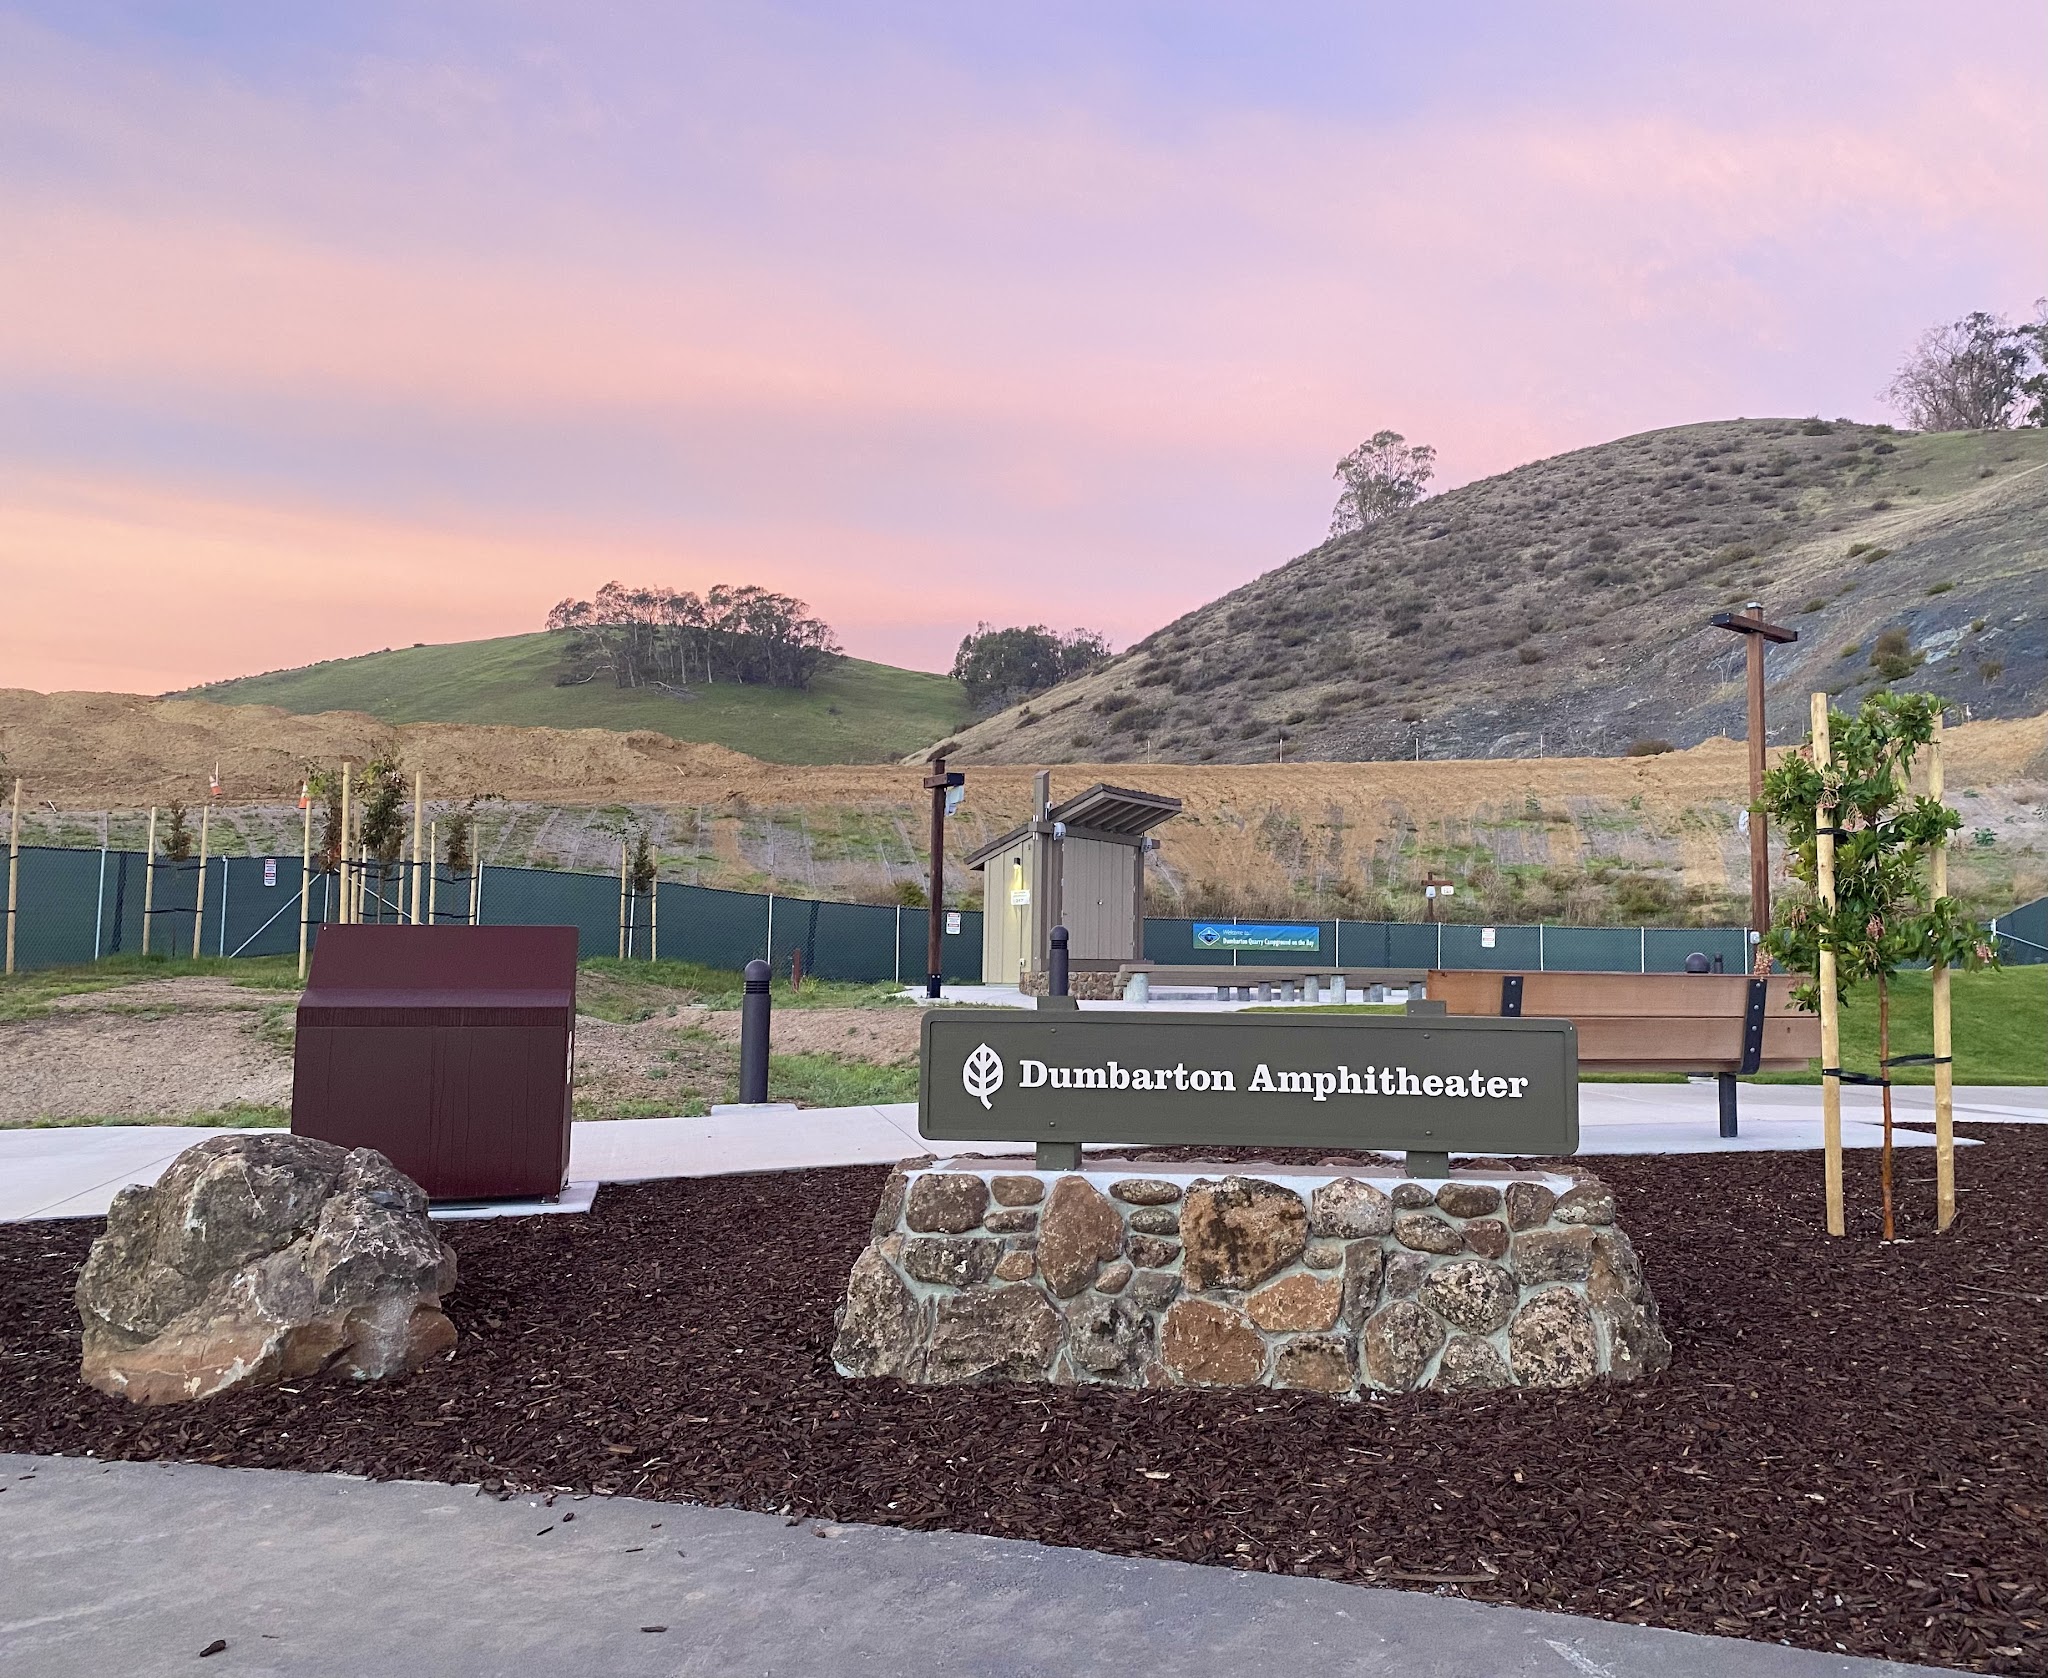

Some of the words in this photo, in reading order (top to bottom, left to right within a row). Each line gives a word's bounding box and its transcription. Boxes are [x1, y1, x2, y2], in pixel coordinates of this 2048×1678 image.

[1248, 938, 1264, 946] Quarry
[1264, 938, 1291, 946] Campground
[1019, 1059, 1236, 1091] Dumbarton
[1247, 1064, 1529, 1101] Amphitheater
